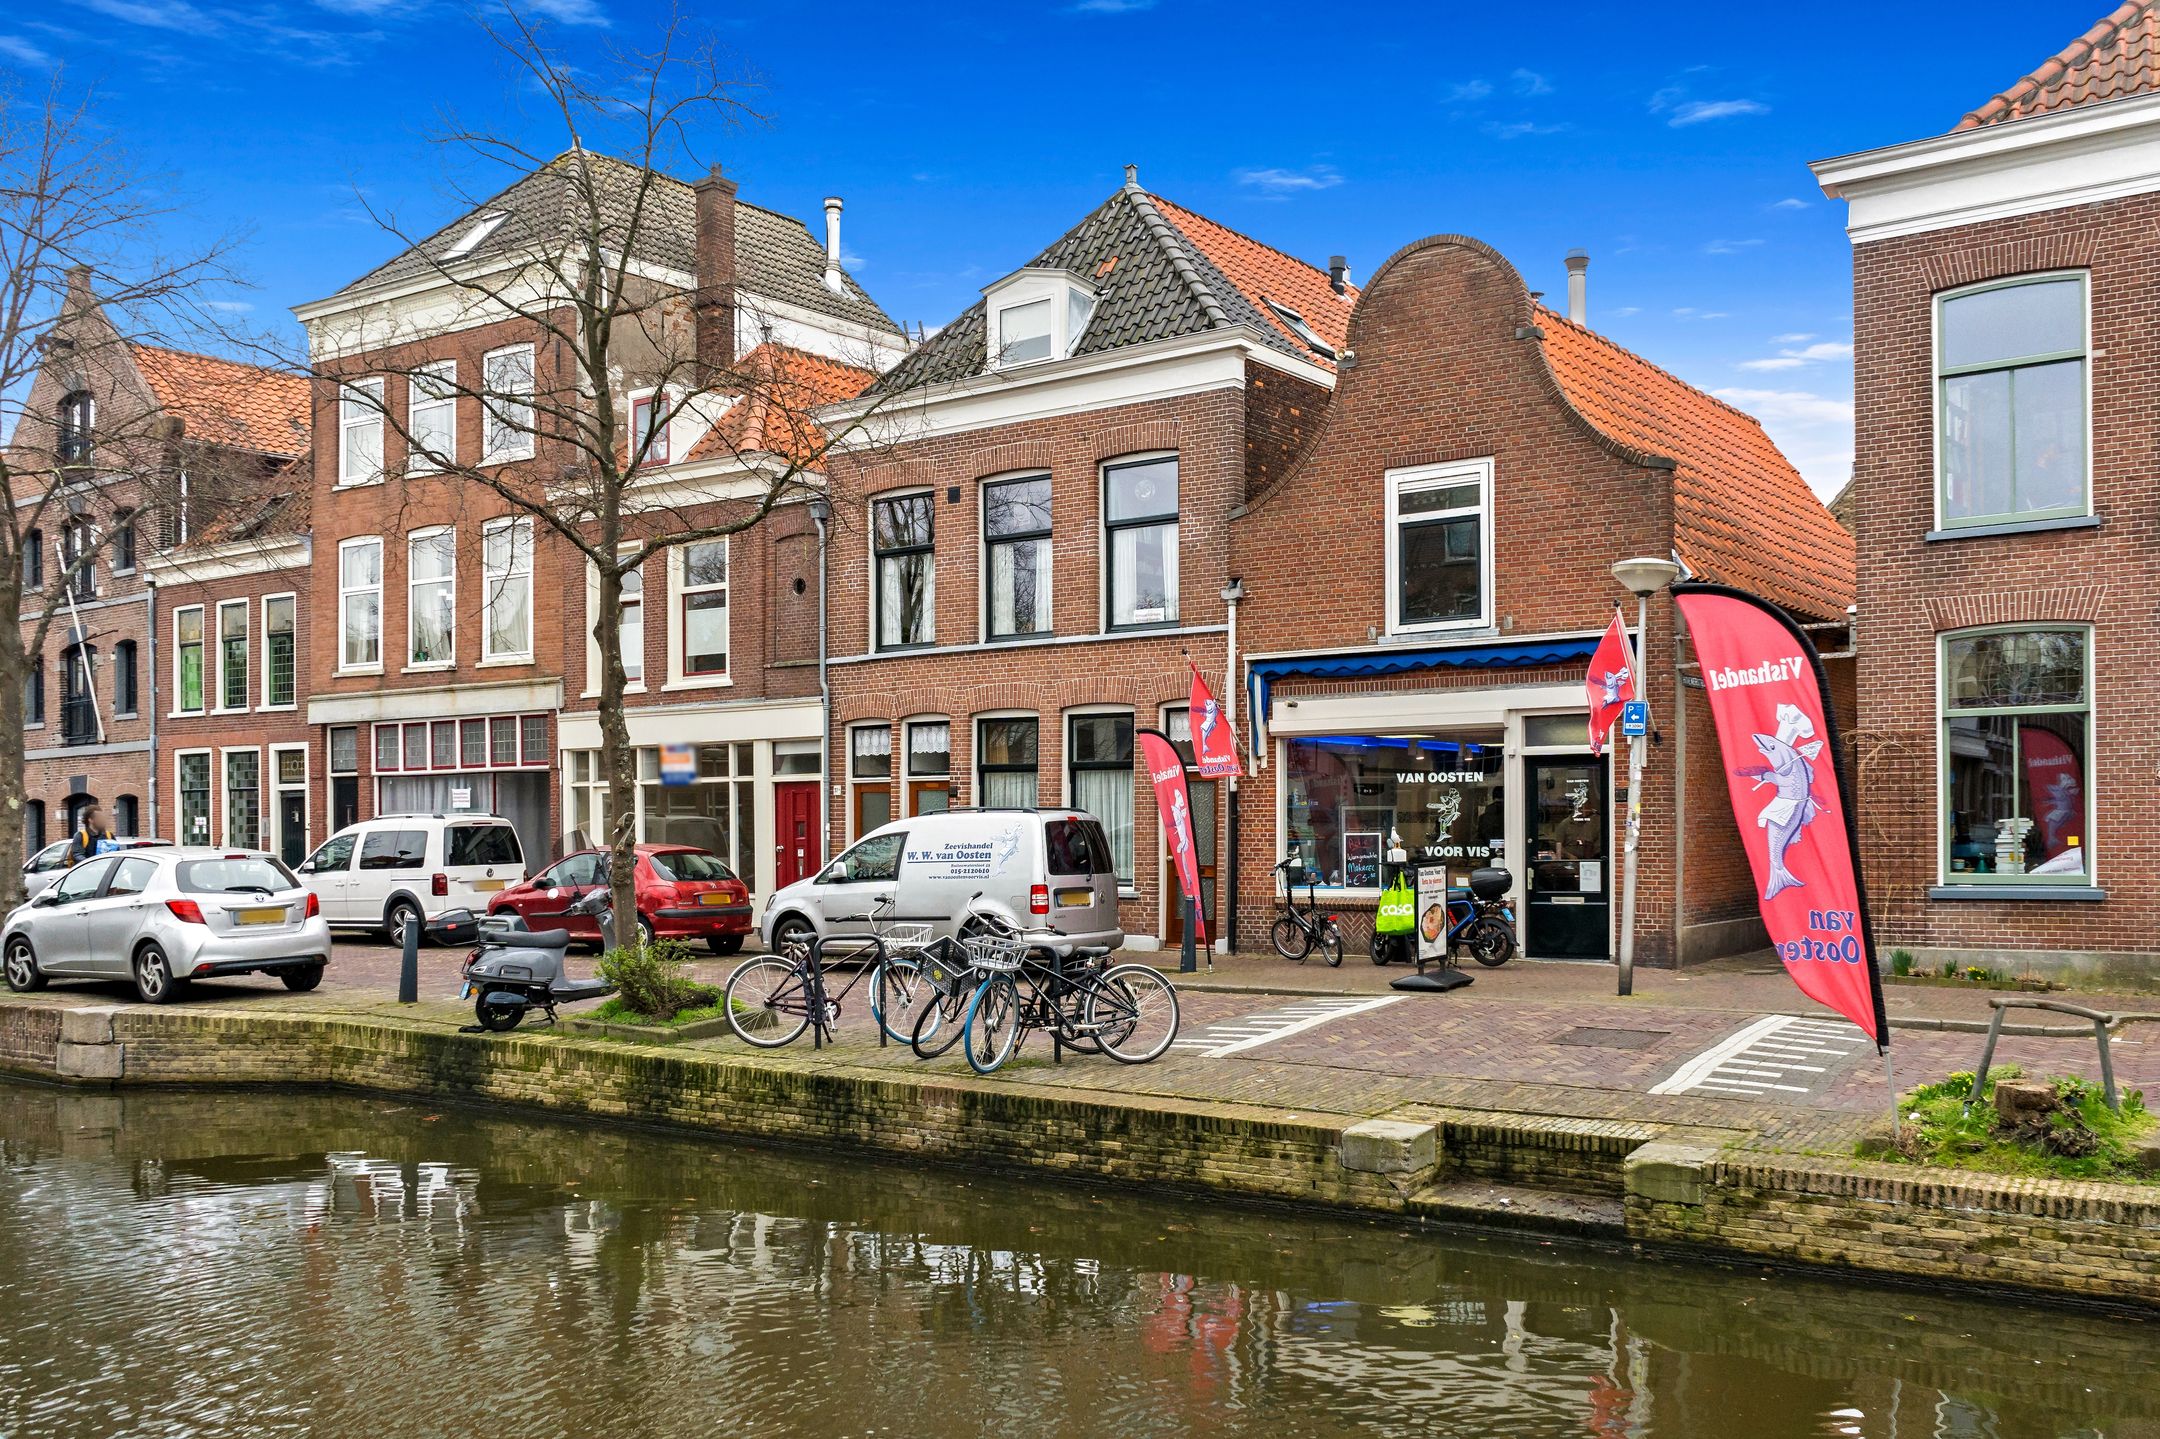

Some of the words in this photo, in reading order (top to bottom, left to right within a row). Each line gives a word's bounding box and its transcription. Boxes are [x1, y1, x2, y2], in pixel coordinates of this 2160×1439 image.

[1628, 705, 1635, 713] P
[1397, 773, 1424, 783] VAN
[1428, 772, 1484, 783] OOSTEN
[944, 842, 993, 850] Zeevishandel
[907, 851, 919, 860] W.
[922, 851, 934, 860] W.
[936, 852, 954, 860] van
[956, 850, 992, 860] Oosten
[1425, 846, 1463, 857] VOOR
[1467, 846, 1490, 857] VIS
